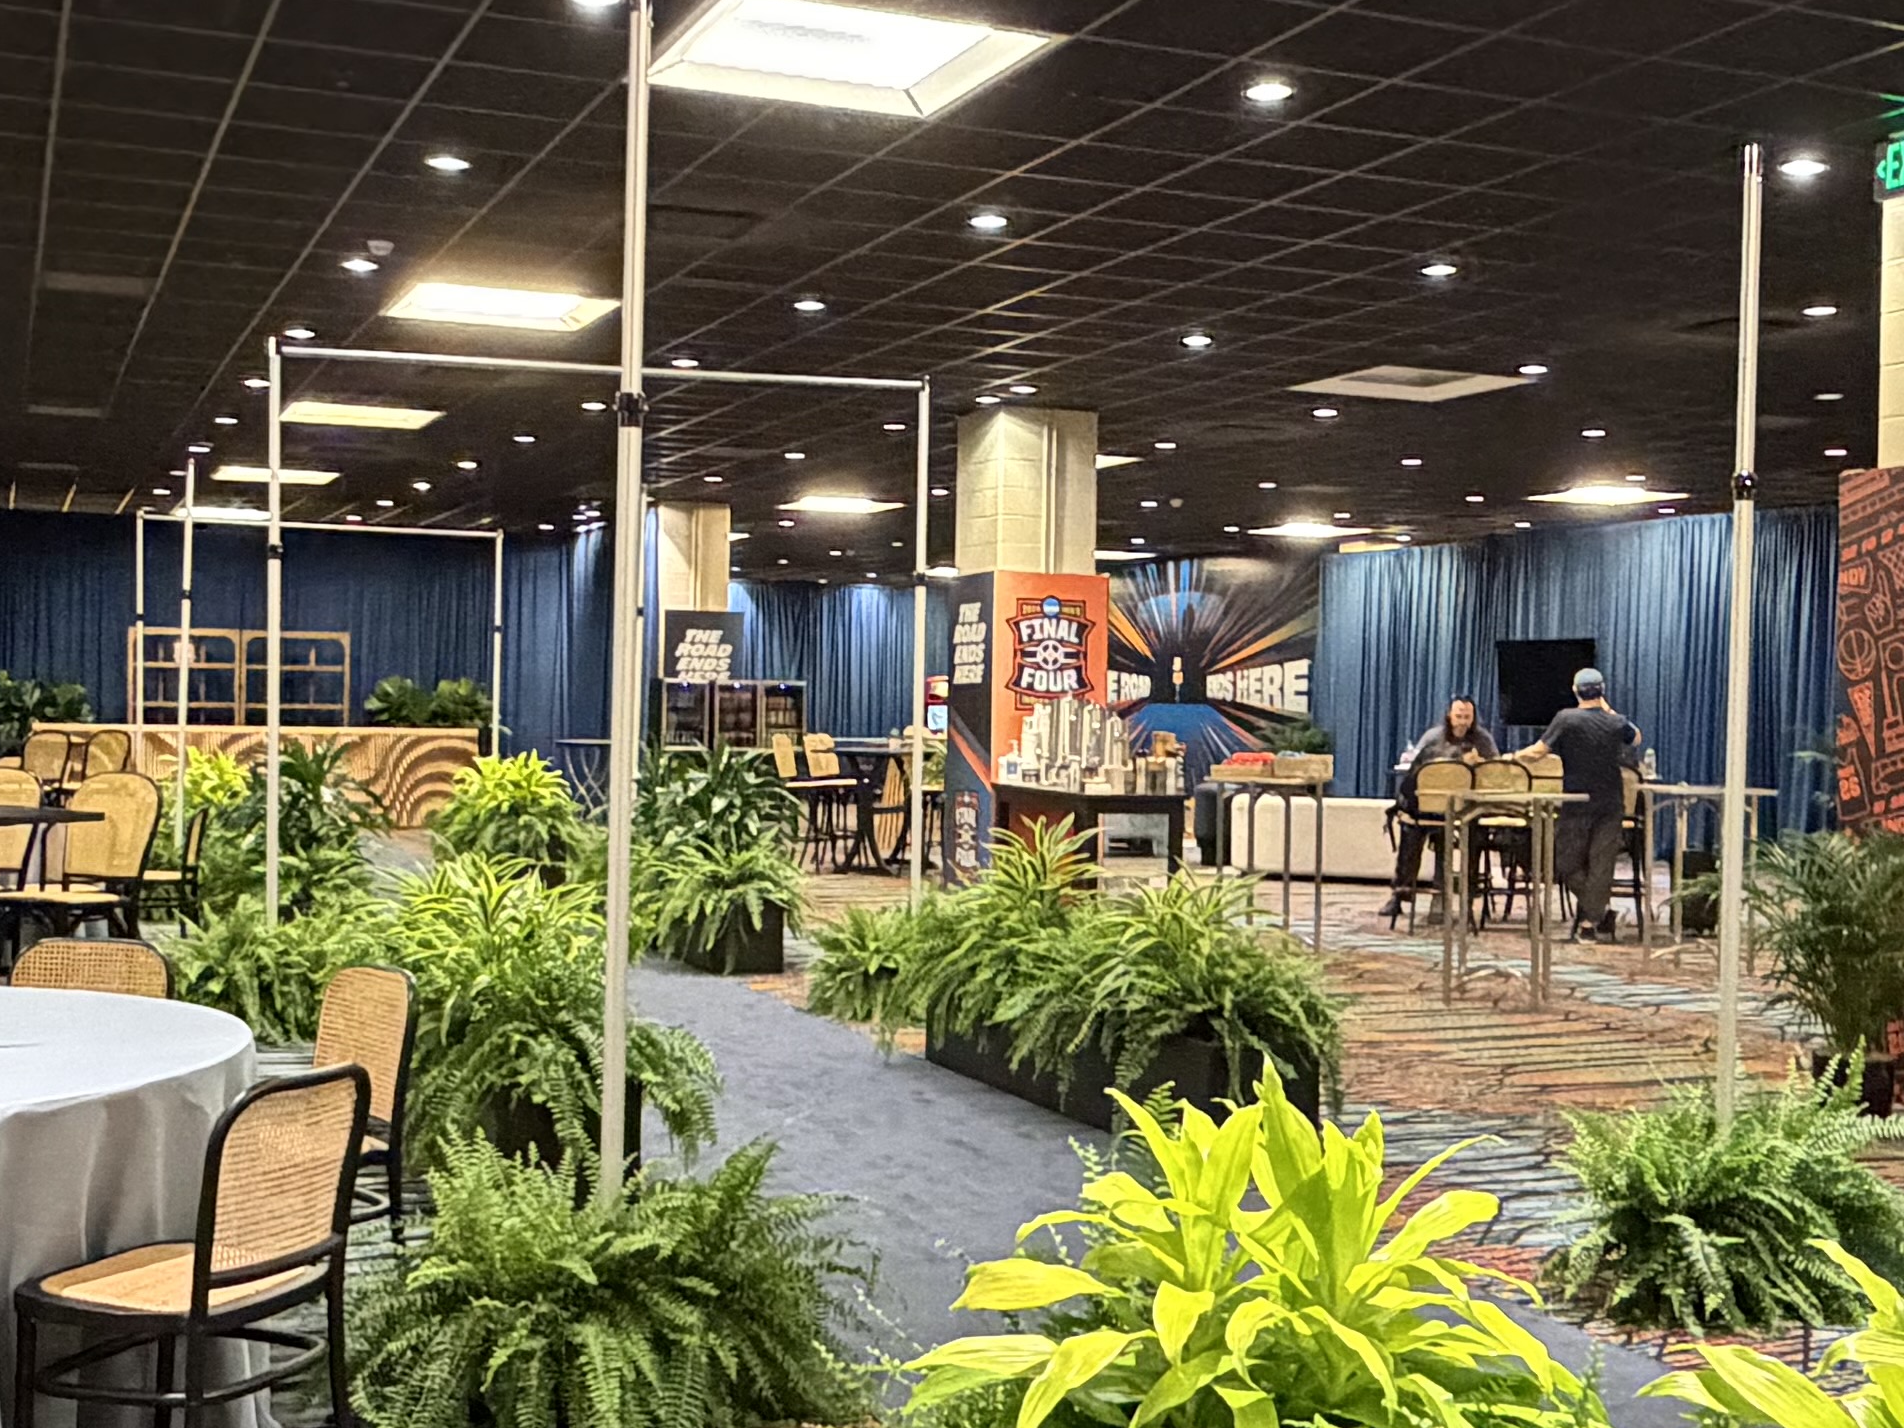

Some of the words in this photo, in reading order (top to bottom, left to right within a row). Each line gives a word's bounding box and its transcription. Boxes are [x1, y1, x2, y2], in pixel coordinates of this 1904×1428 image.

[1840, 565, 1867, 586] NDY
[684, 628, 724, 643] THE
[1019, 618, 1080, 644] FINAL
[675, 642, 733, 658] ROAD
[675, 657, 731, 671] ENDS
[1021, 666, 1079, 692] FOUR
[1236, 658, 1313, 713] HERE
